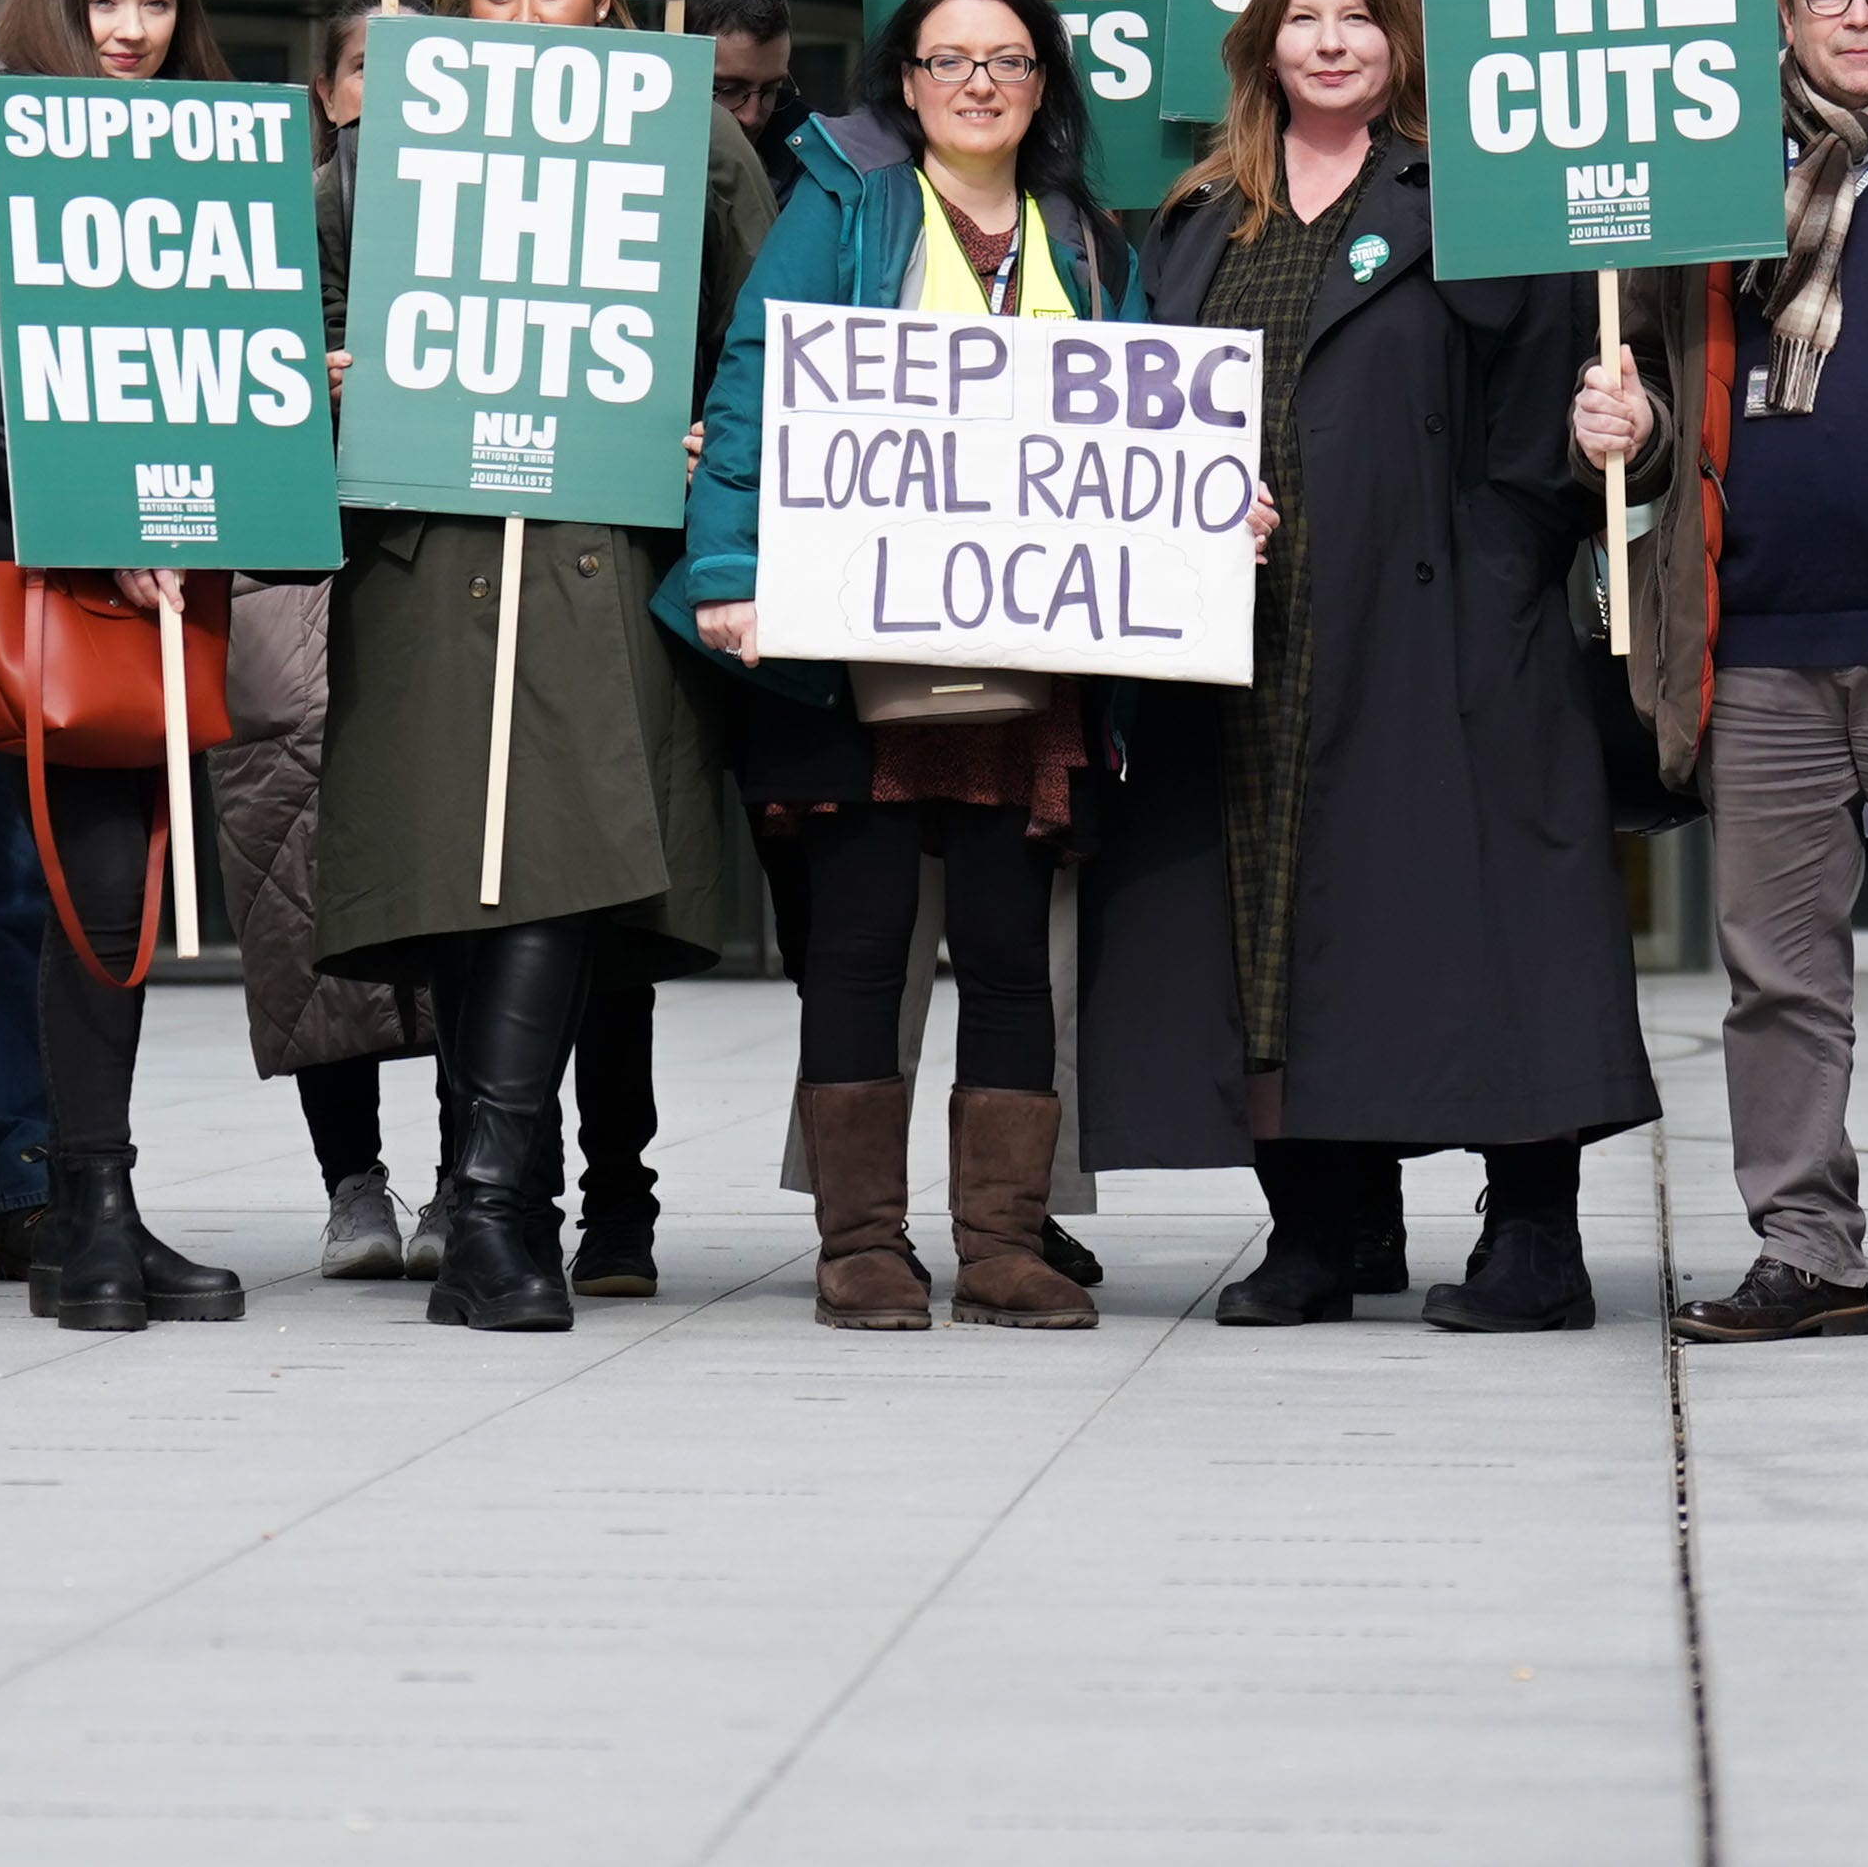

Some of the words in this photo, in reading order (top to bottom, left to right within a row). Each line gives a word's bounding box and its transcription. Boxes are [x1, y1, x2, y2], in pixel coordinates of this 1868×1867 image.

[5, 95, 290, 162] SUPPORT
[402, 37, 673, 146] STOP
[1469, 42, 1740, 154] CUTS
[397, 147, 666, 293] THE
[1566, 162, 1649, 199] NUJ
[1568, 204, 1616, 215] NATIONAL
[1619, 202, 1650, 212] UNION
[10, 197, 302, 290] LOCAL
[1349, 243, 1386, 263] STRIKE
[1569, 223, 1651, 238] JOURNALISTS
[18, 326, 311, 426] NEWS
[385, 291, 654, 404] CUTS
[781, 313, 1008, 415] KEEP
[1052, 338, 1251, 430] BBC
[472, 451, 520, 462] NATIONAL
[523, 454, 554, 464] UNION
[473, 412, 556, 450] NUJ
[136, 465, 213, 499] NUJ
[470, 472, 552, 487] JOURNALISTS
[778, 424, 991, 513] LOCAL
[1018, 434, 1252, 533] RADIO
[873, 536, 1183, 640] LOCAL
